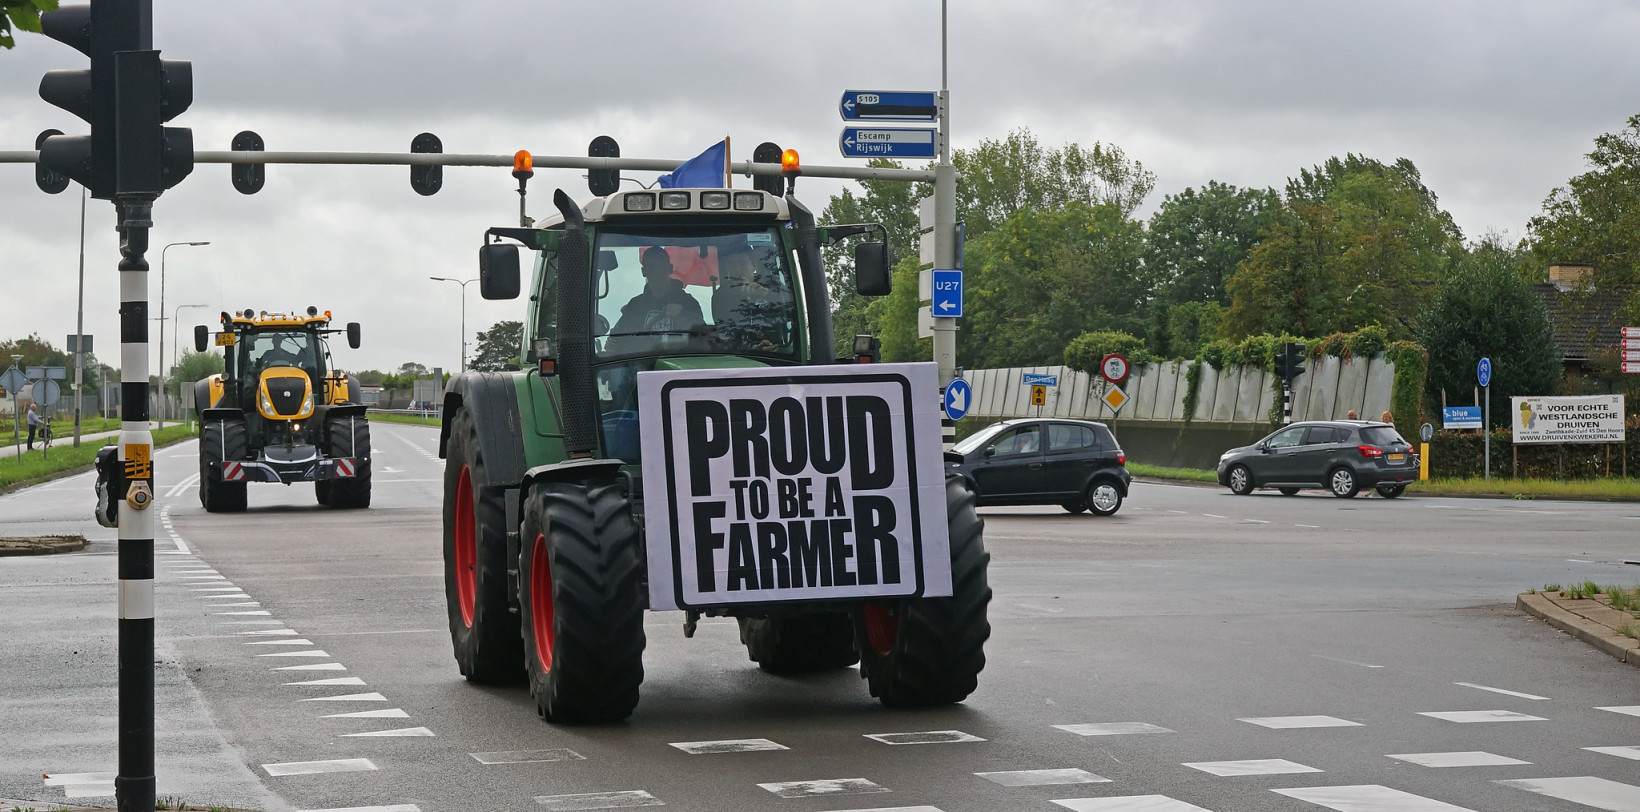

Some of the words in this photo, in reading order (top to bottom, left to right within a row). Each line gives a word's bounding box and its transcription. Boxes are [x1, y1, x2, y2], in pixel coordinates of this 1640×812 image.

[858, 132, 891, 141] Escamp
[856, 143, 893, 154] Rijswijk
[936, 281, 959, 291] U27
[1577, 403, 1609, 411] ECHTE
[1539, 412, 1618, 420] WESTLANDSCHE
[1557, 421, 1600, 429] DRUIVEN
[1519, 433, 1619, 441] WWW.DRUIVENKWEKERIJ.NL
[685, 395, 895, 497] PROUD
[729, 479, 769, 521] TO
[777, 477, 815, 519] BE
[825, 477, 847, 517] A
[692, 495, 901, 593] FARMER
